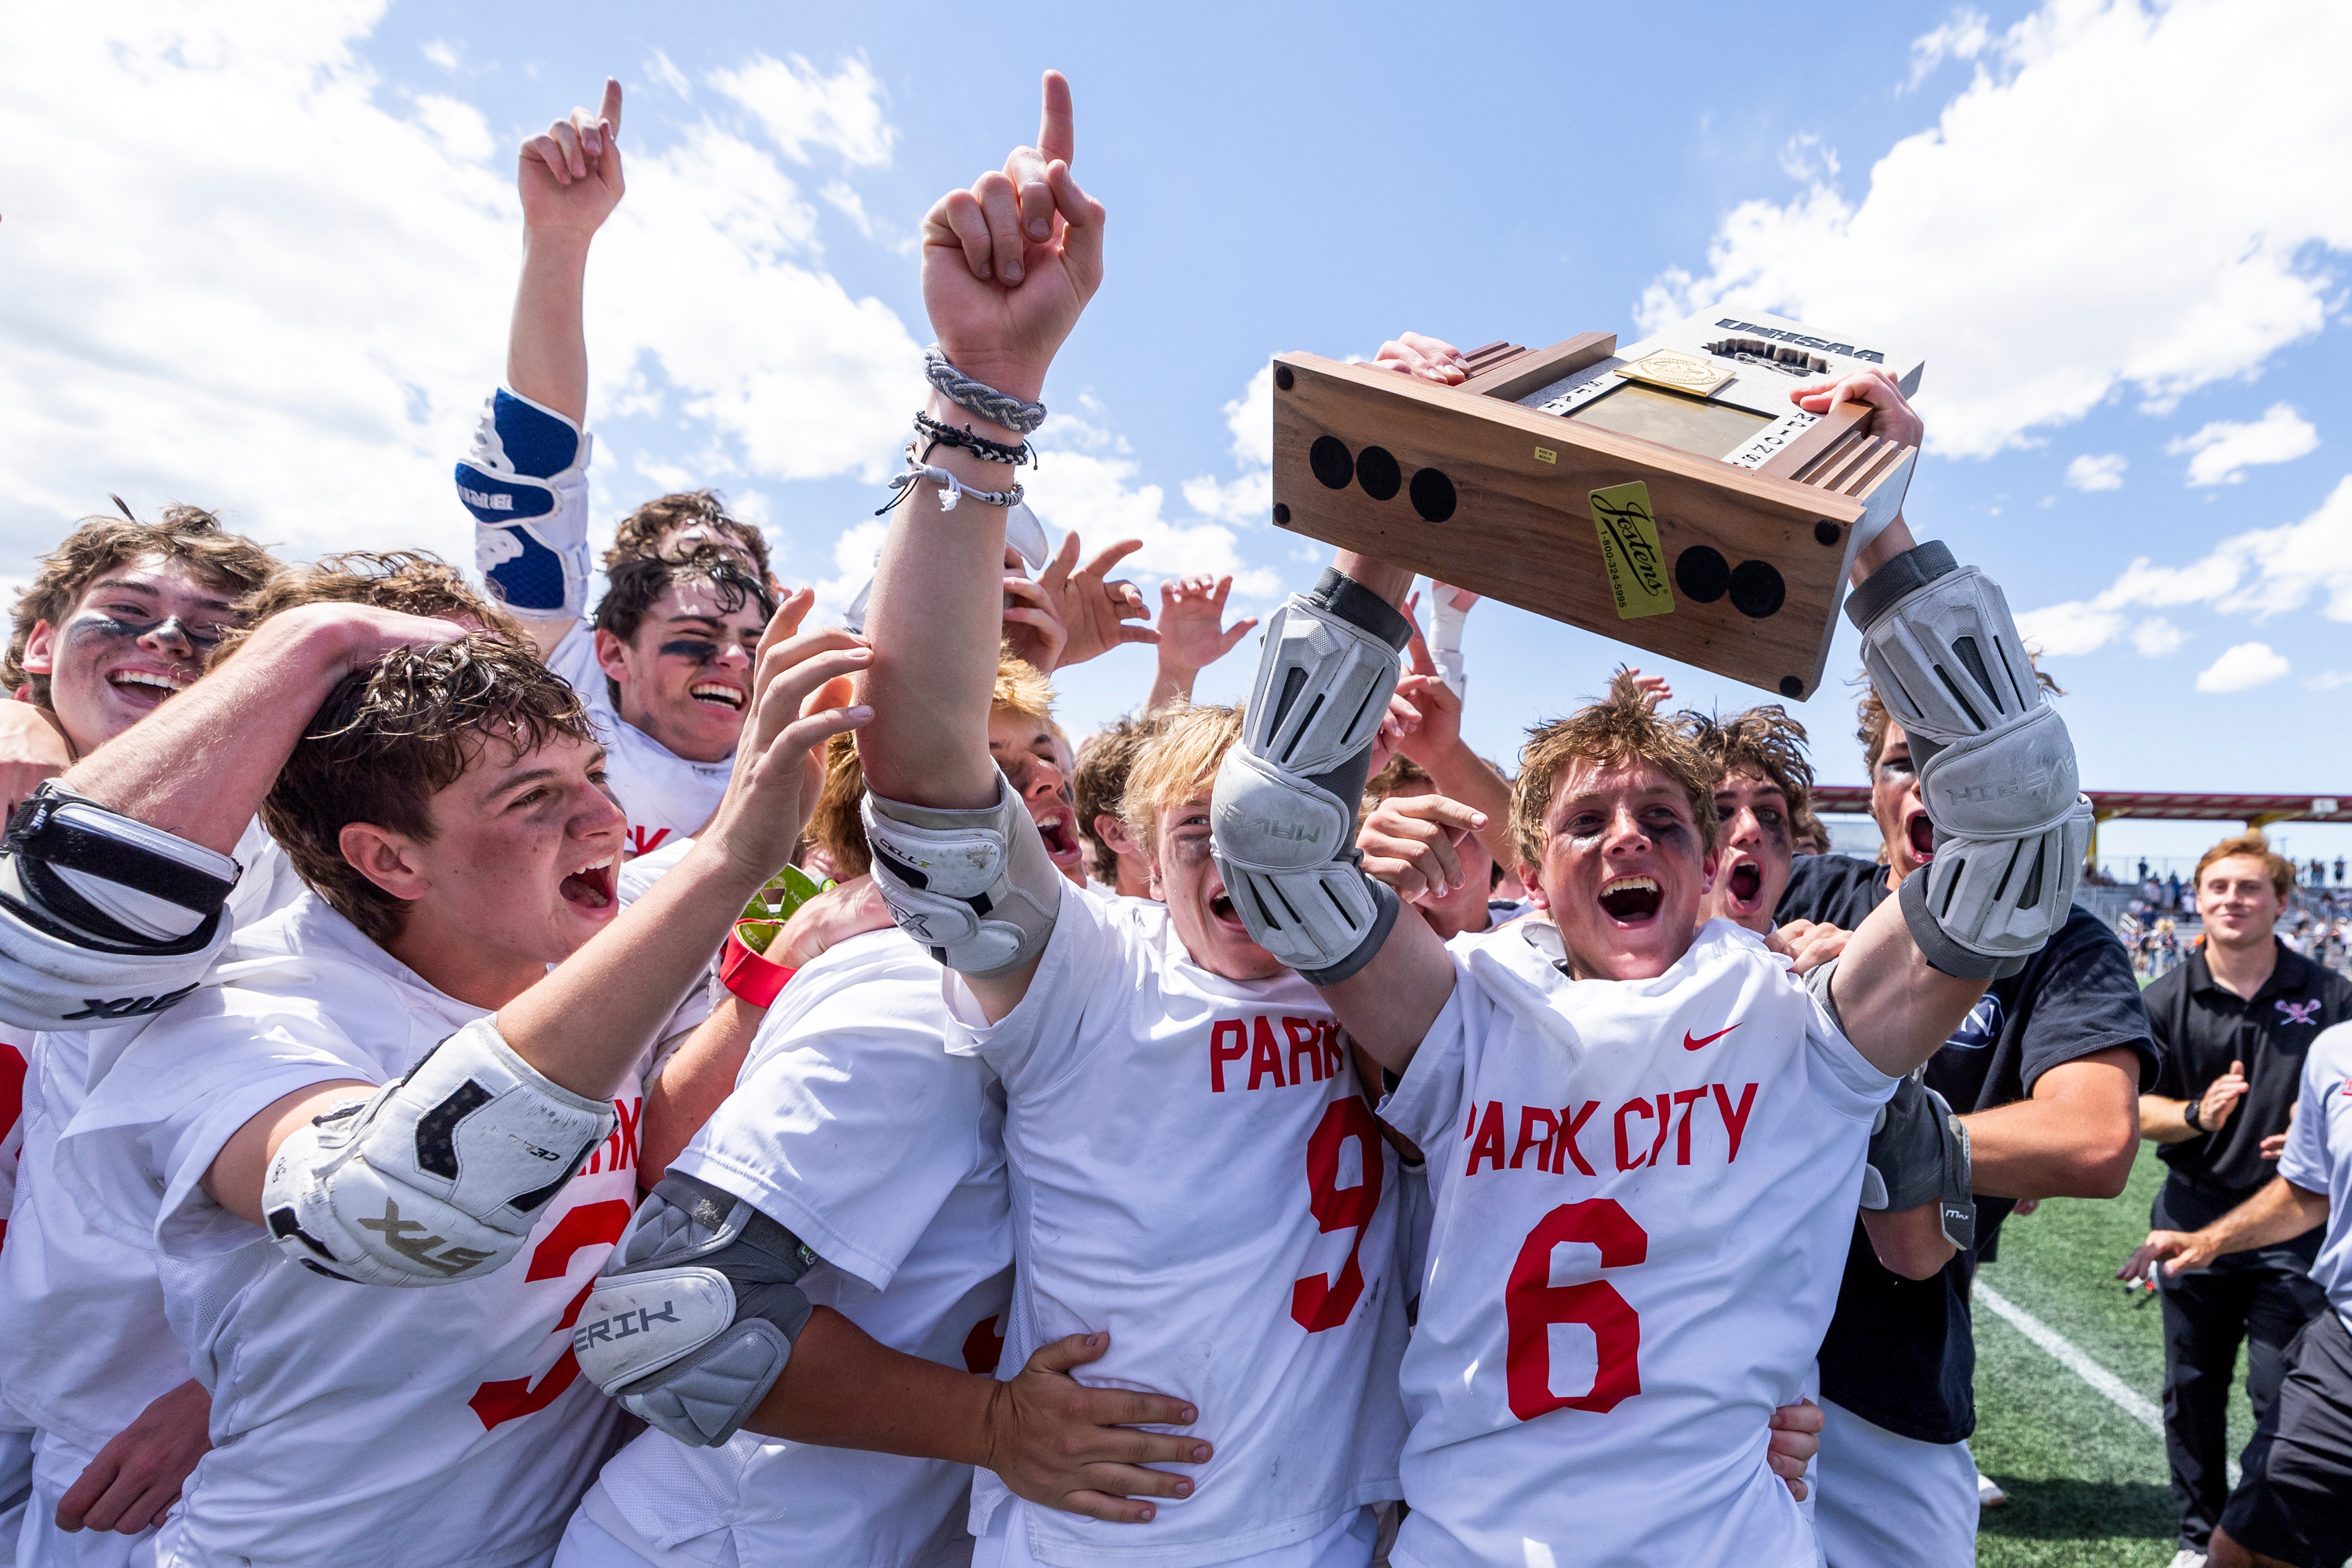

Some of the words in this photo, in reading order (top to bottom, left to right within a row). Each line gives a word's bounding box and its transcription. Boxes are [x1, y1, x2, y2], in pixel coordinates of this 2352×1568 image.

[1591, 494, 1664, 596] Jostens
[1600, 530, 1627, 608] 1-800-324-5995
[880, 838, 918, 865] CELL
[1210, 1015, 1345, 1093] PARK
[1613, 1083, 1759, 1174] CITY
[1290, 1094, 1382, 1334] 9
[1505, 1198, 1647, 1421] 6
